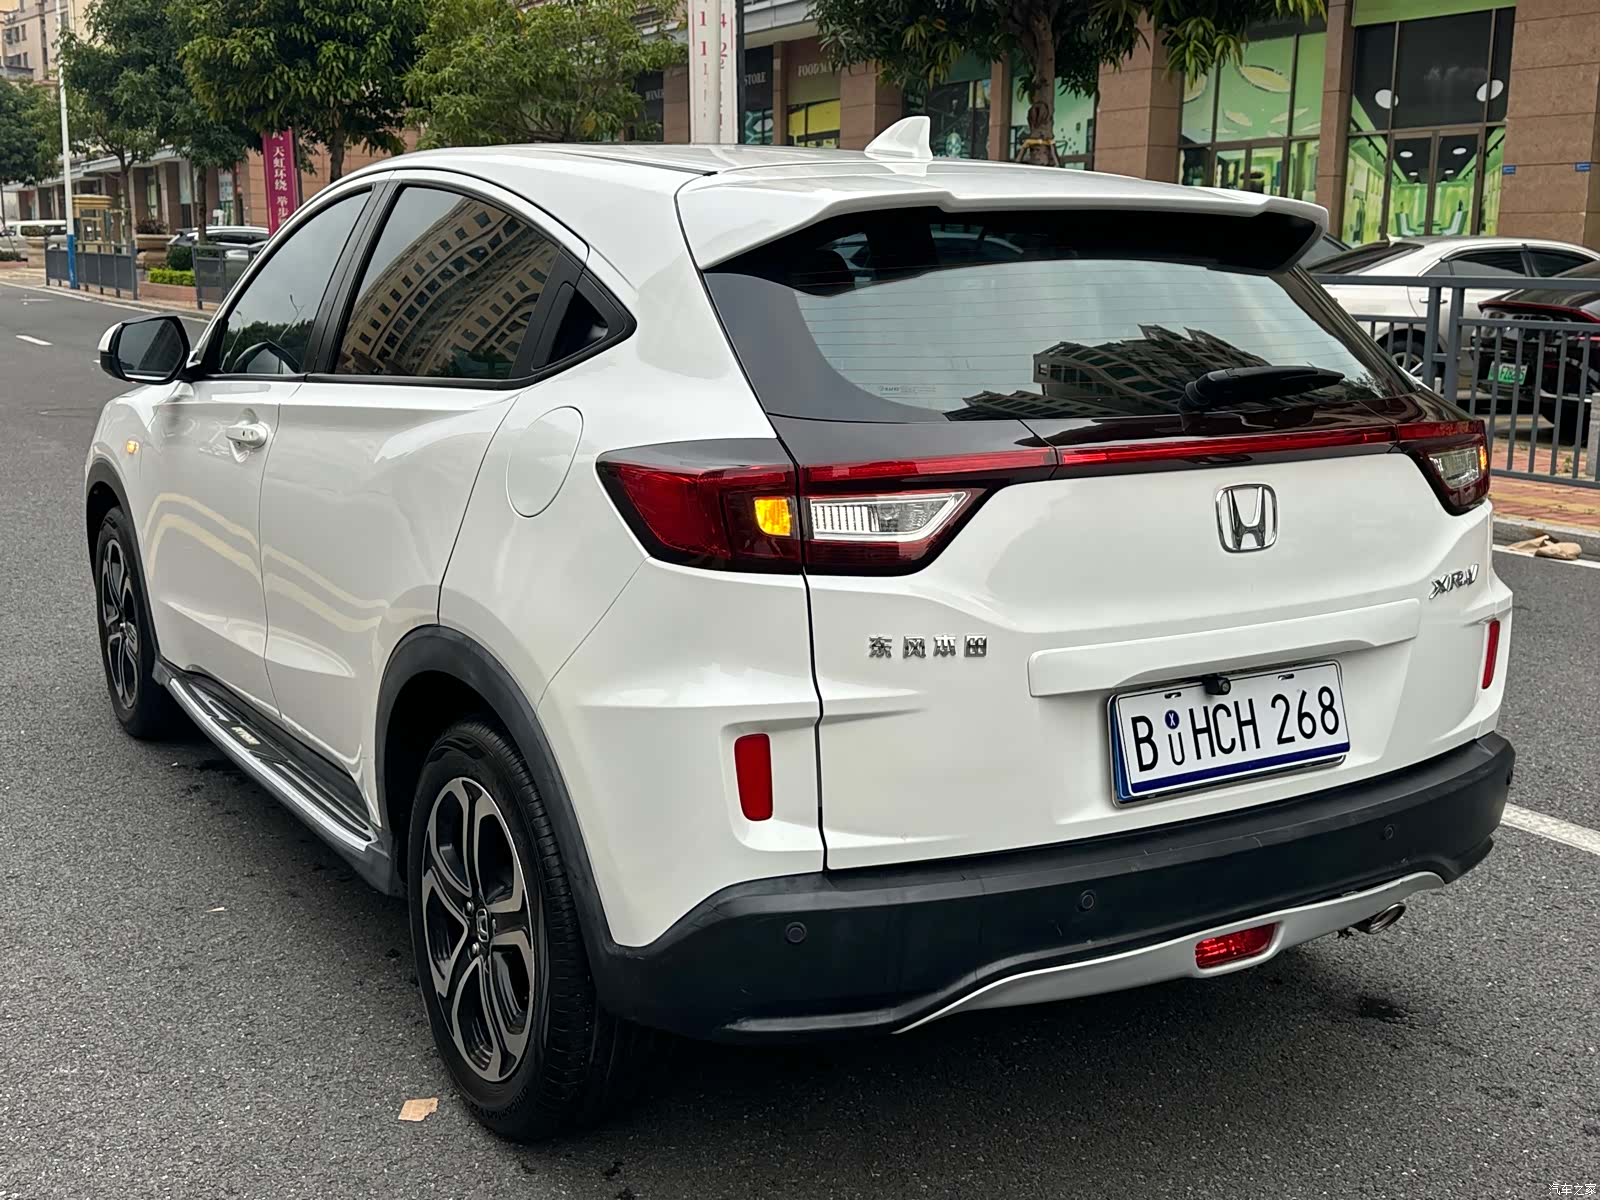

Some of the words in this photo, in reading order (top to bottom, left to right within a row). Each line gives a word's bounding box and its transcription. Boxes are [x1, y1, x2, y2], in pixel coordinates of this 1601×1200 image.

[273, 146, 288, 191] 天虹环绕
[868, 635, 988, 659] 东风本田
[1130, 715, 1159, 772] B
[1270, 686, 1340, 746] 268
